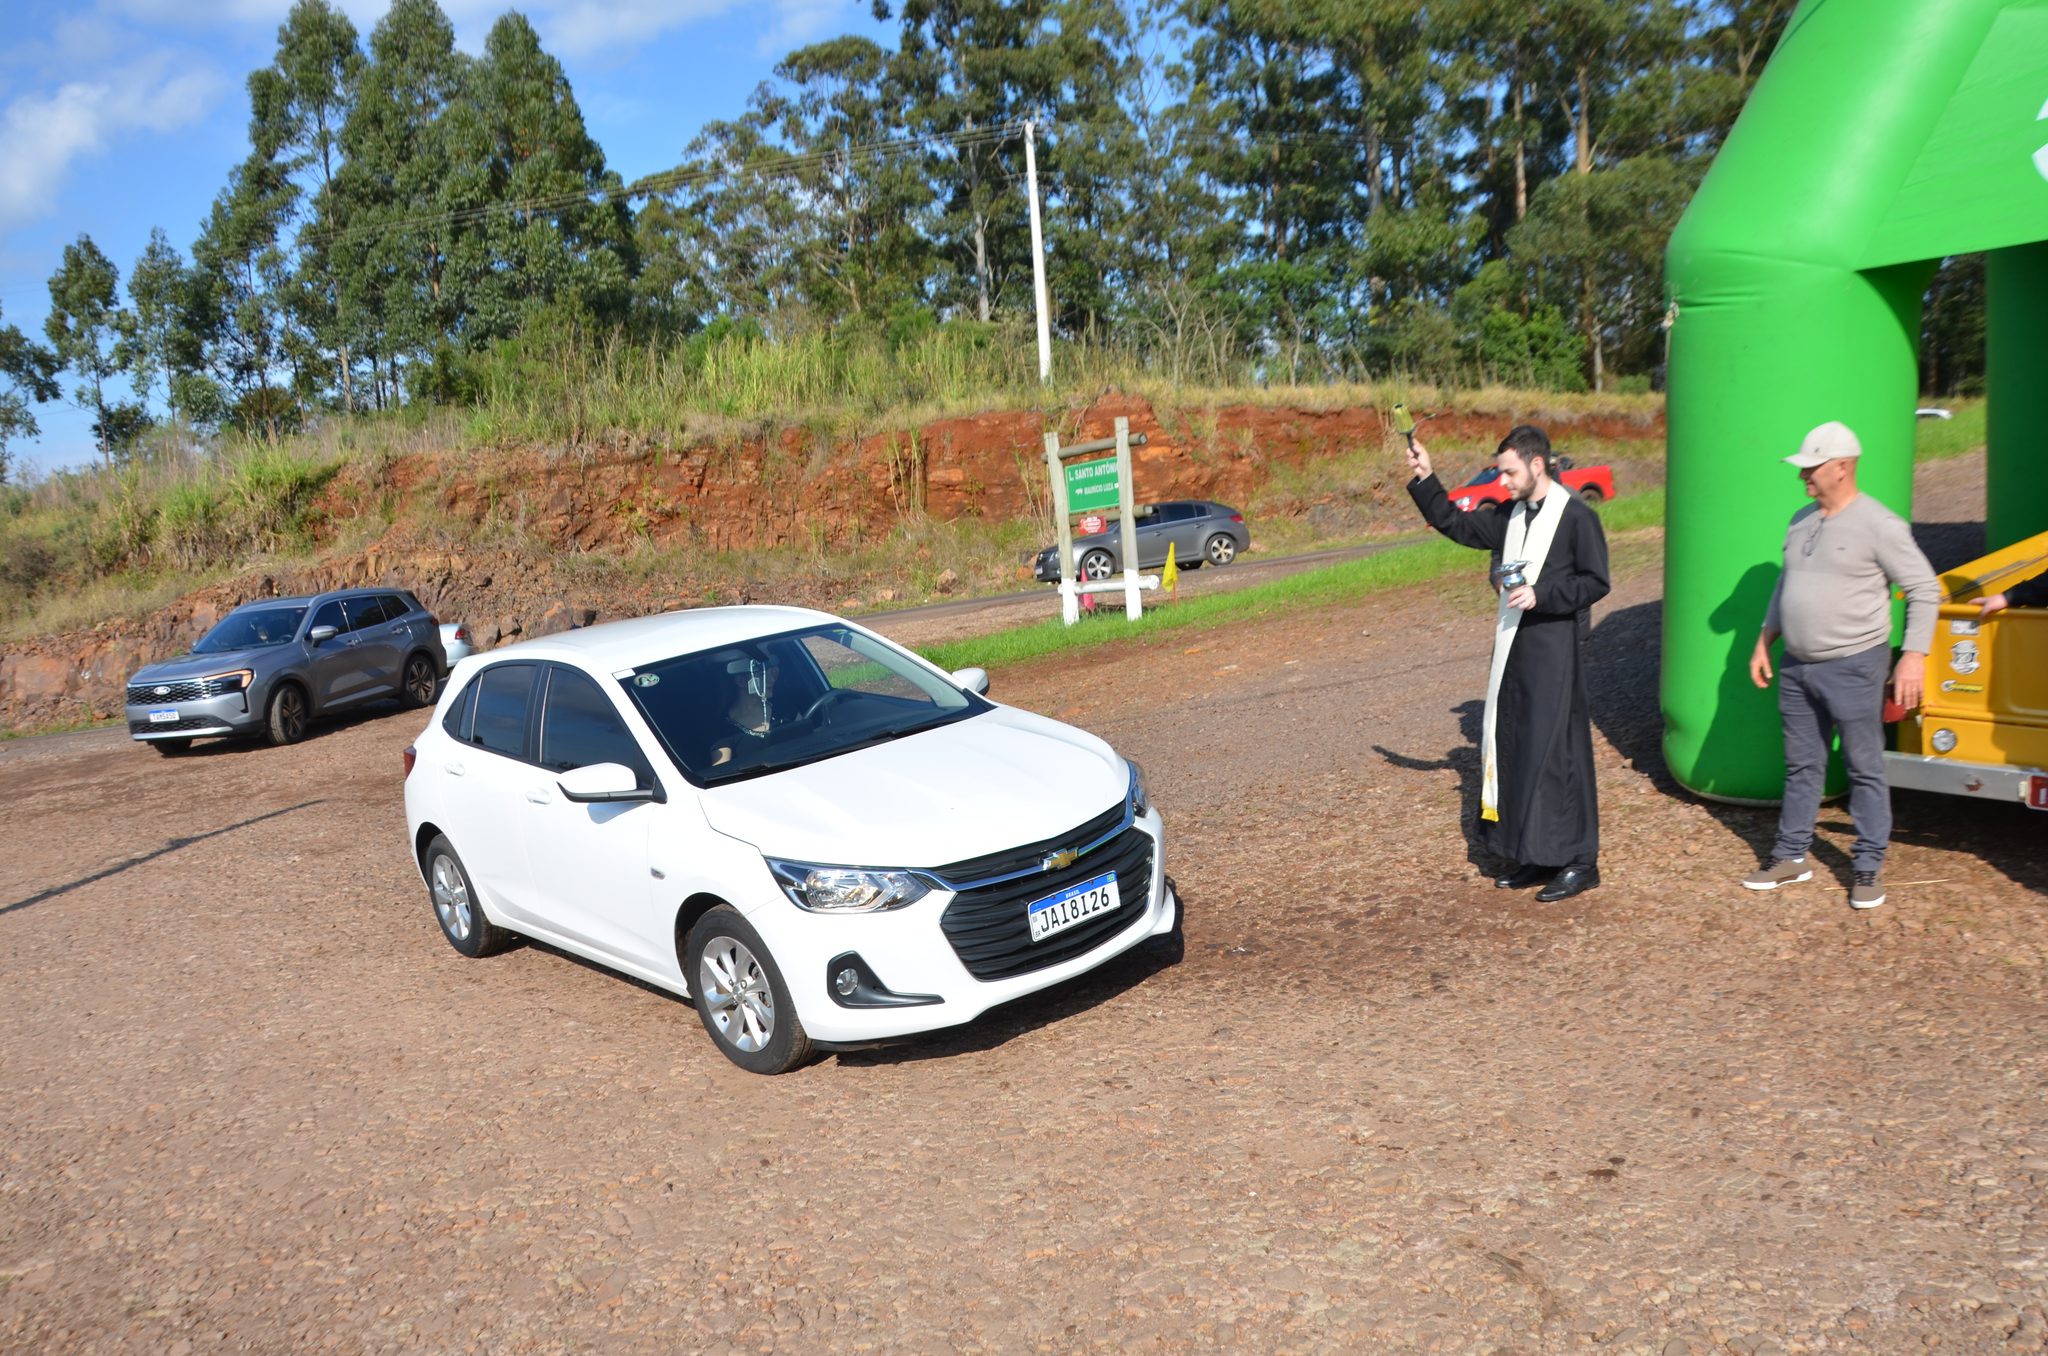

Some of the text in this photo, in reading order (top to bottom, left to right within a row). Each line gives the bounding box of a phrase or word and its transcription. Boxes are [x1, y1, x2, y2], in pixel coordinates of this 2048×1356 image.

[1075, 467, 1093, 479] SANTO
[1095, 462, 1118, 476] ANTÔNI
[1065, 889, 1080, 898] BRASIL
[1041, 887, 1109, 932] JAI8I26
